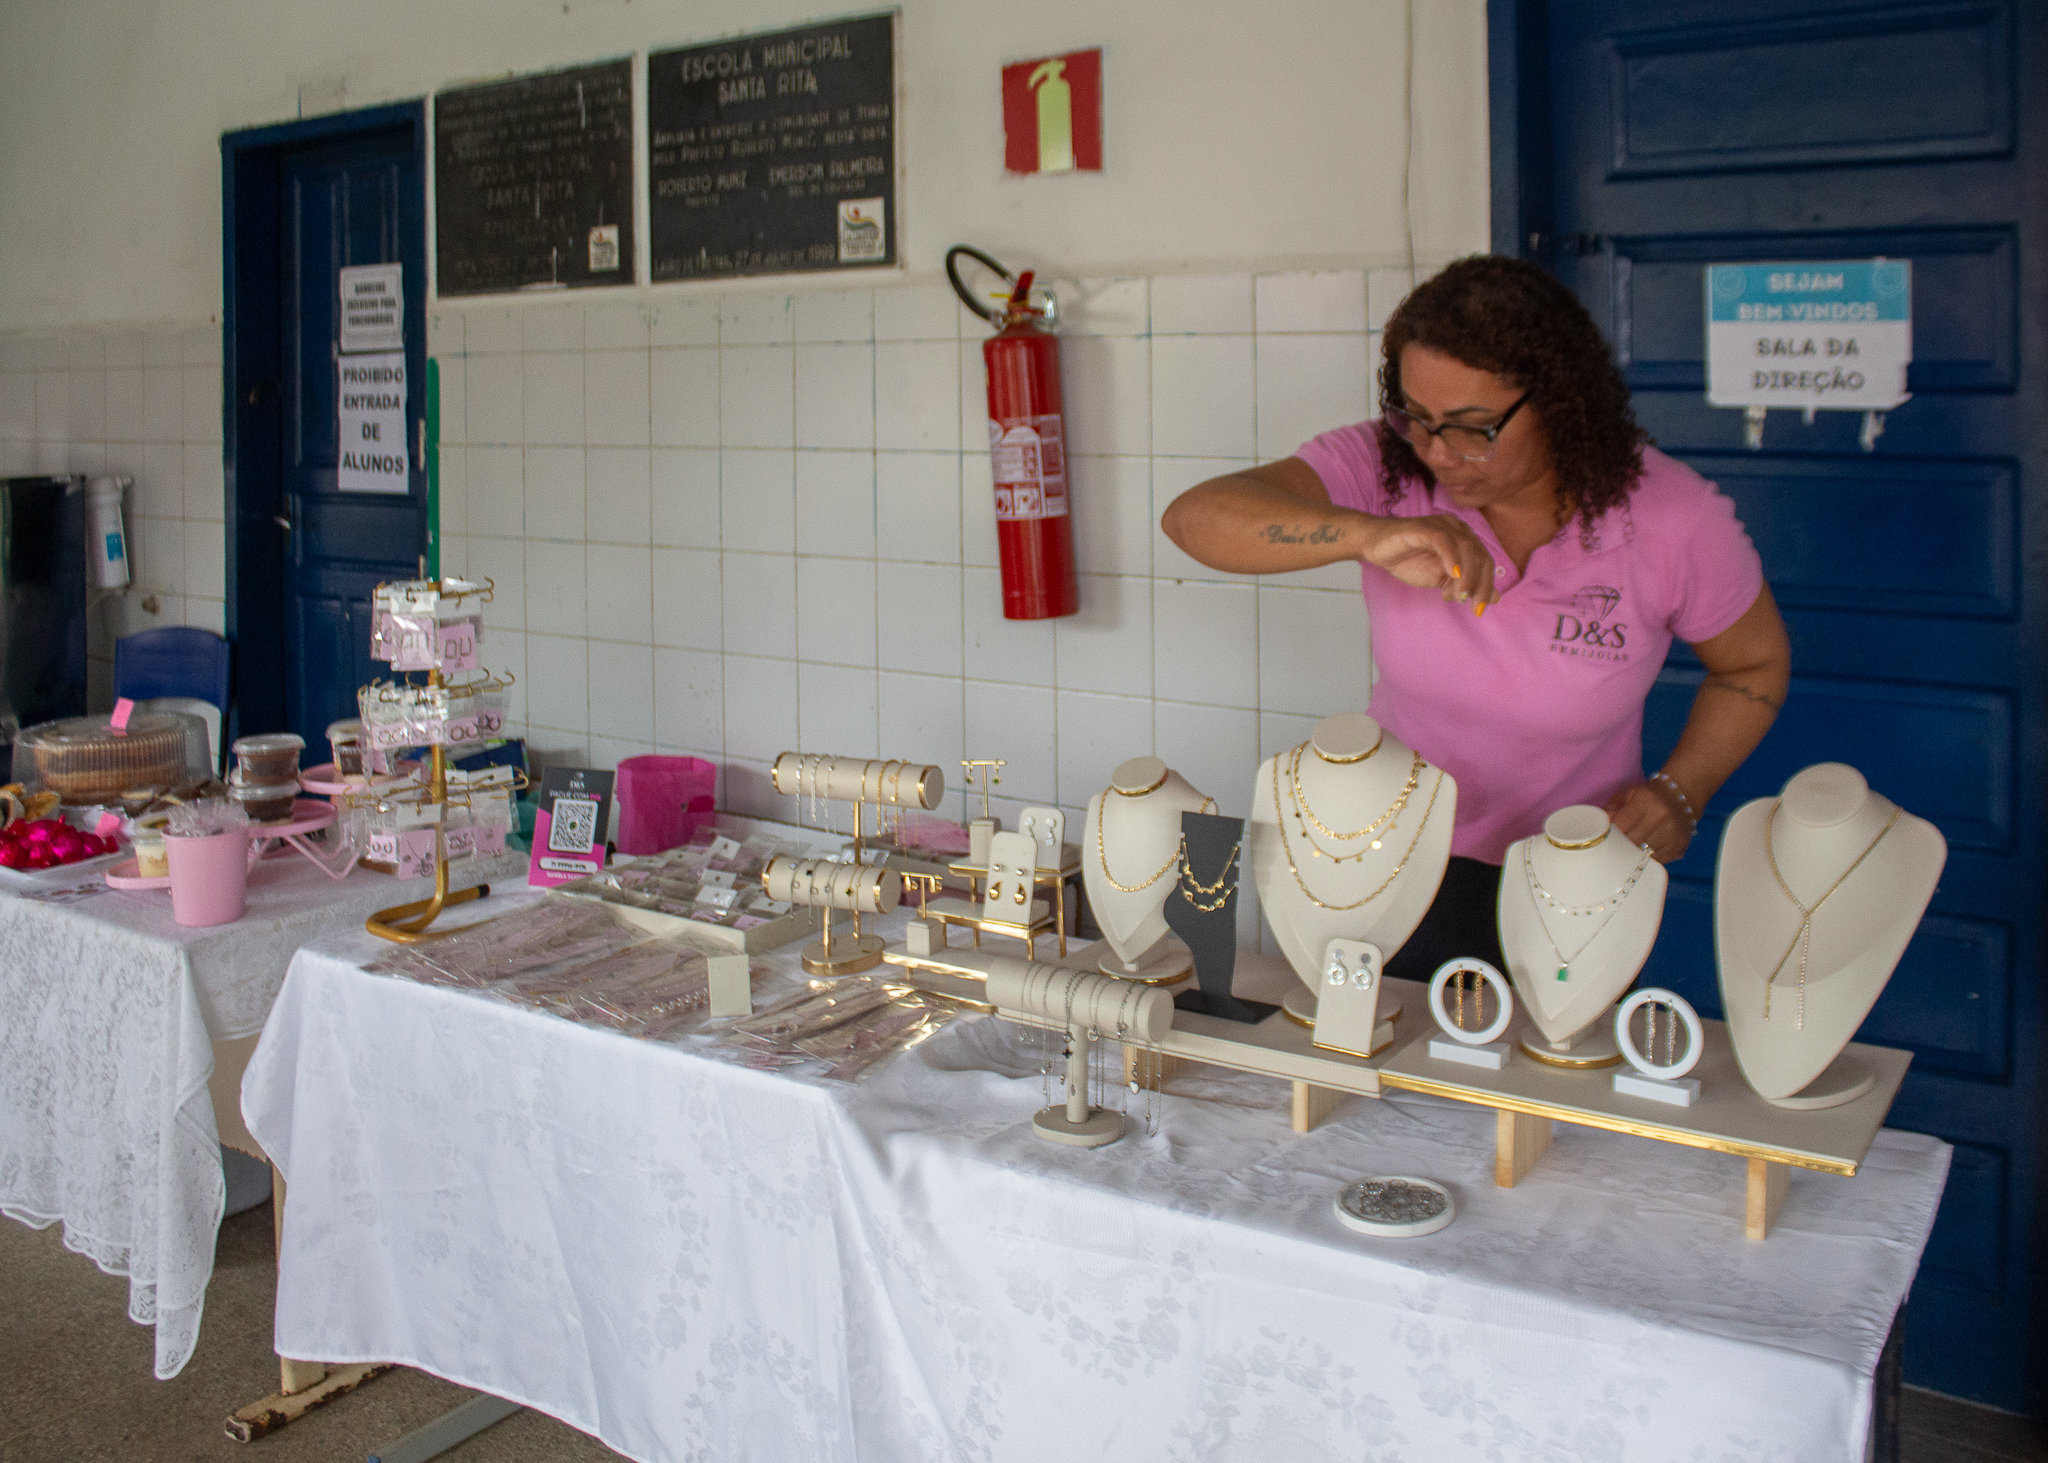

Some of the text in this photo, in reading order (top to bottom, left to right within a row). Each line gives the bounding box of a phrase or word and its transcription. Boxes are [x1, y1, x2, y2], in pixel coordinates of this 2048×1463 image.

[682, 34, 852, 83] ESCOLA MUNICIPAL
[718, 68, 818, 106] SANTA RITA
[768, 155, 885, 187] EMERSON PALMEIRA
[658, 174, 713, 197] ROBERTO
[1768, 272, 1844, 291] SEJAM
[1757, 338, 1860, 356] SALA DA
[343, 367, 404, 384] PROIBIDO
[1754, 366, 1866, 395] DIREÇÃO
[344, 394, 401, 411] ENTRADA
[362, 422, 381, 441] DE
[343, 453, 404, 475] ALUNOS
[1551, 613, 1627, 649] D&S
